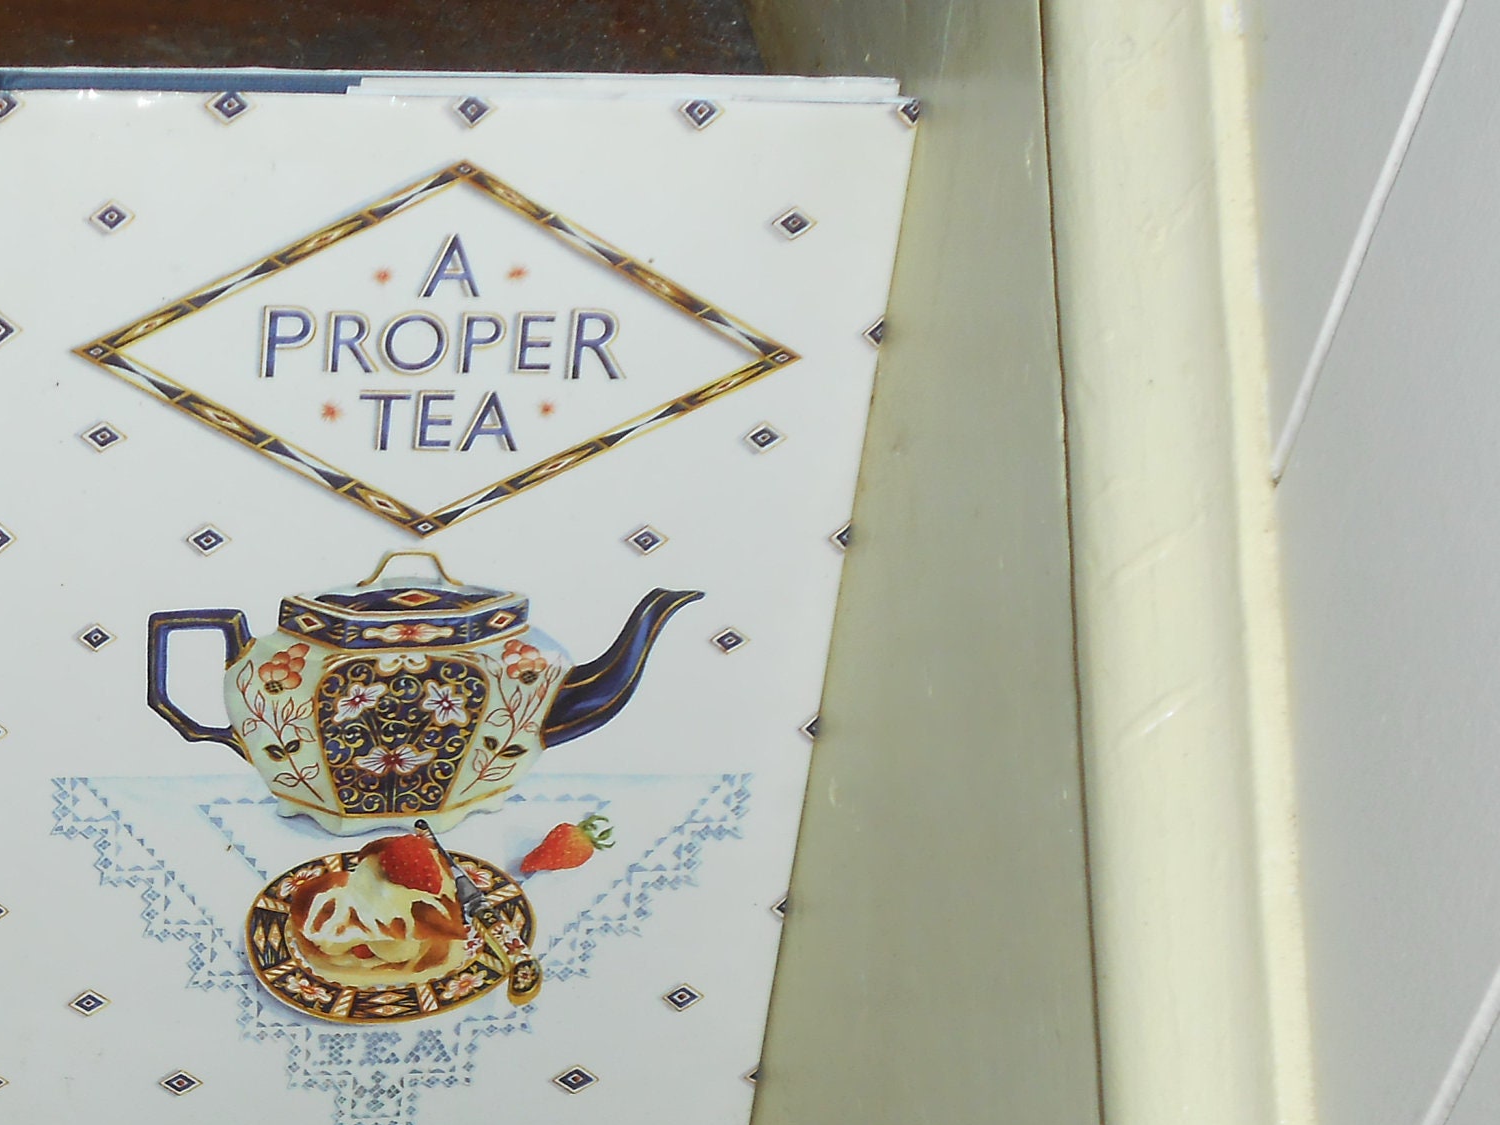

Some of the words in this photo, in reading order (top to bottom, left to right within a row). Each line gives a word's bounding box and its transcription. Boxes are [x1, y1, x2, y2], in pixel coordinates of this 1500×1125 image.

[419, 233, 480, 298] A
[258, 305, 627, 381] PROPER
[359, 389, 518, 452] TEA
